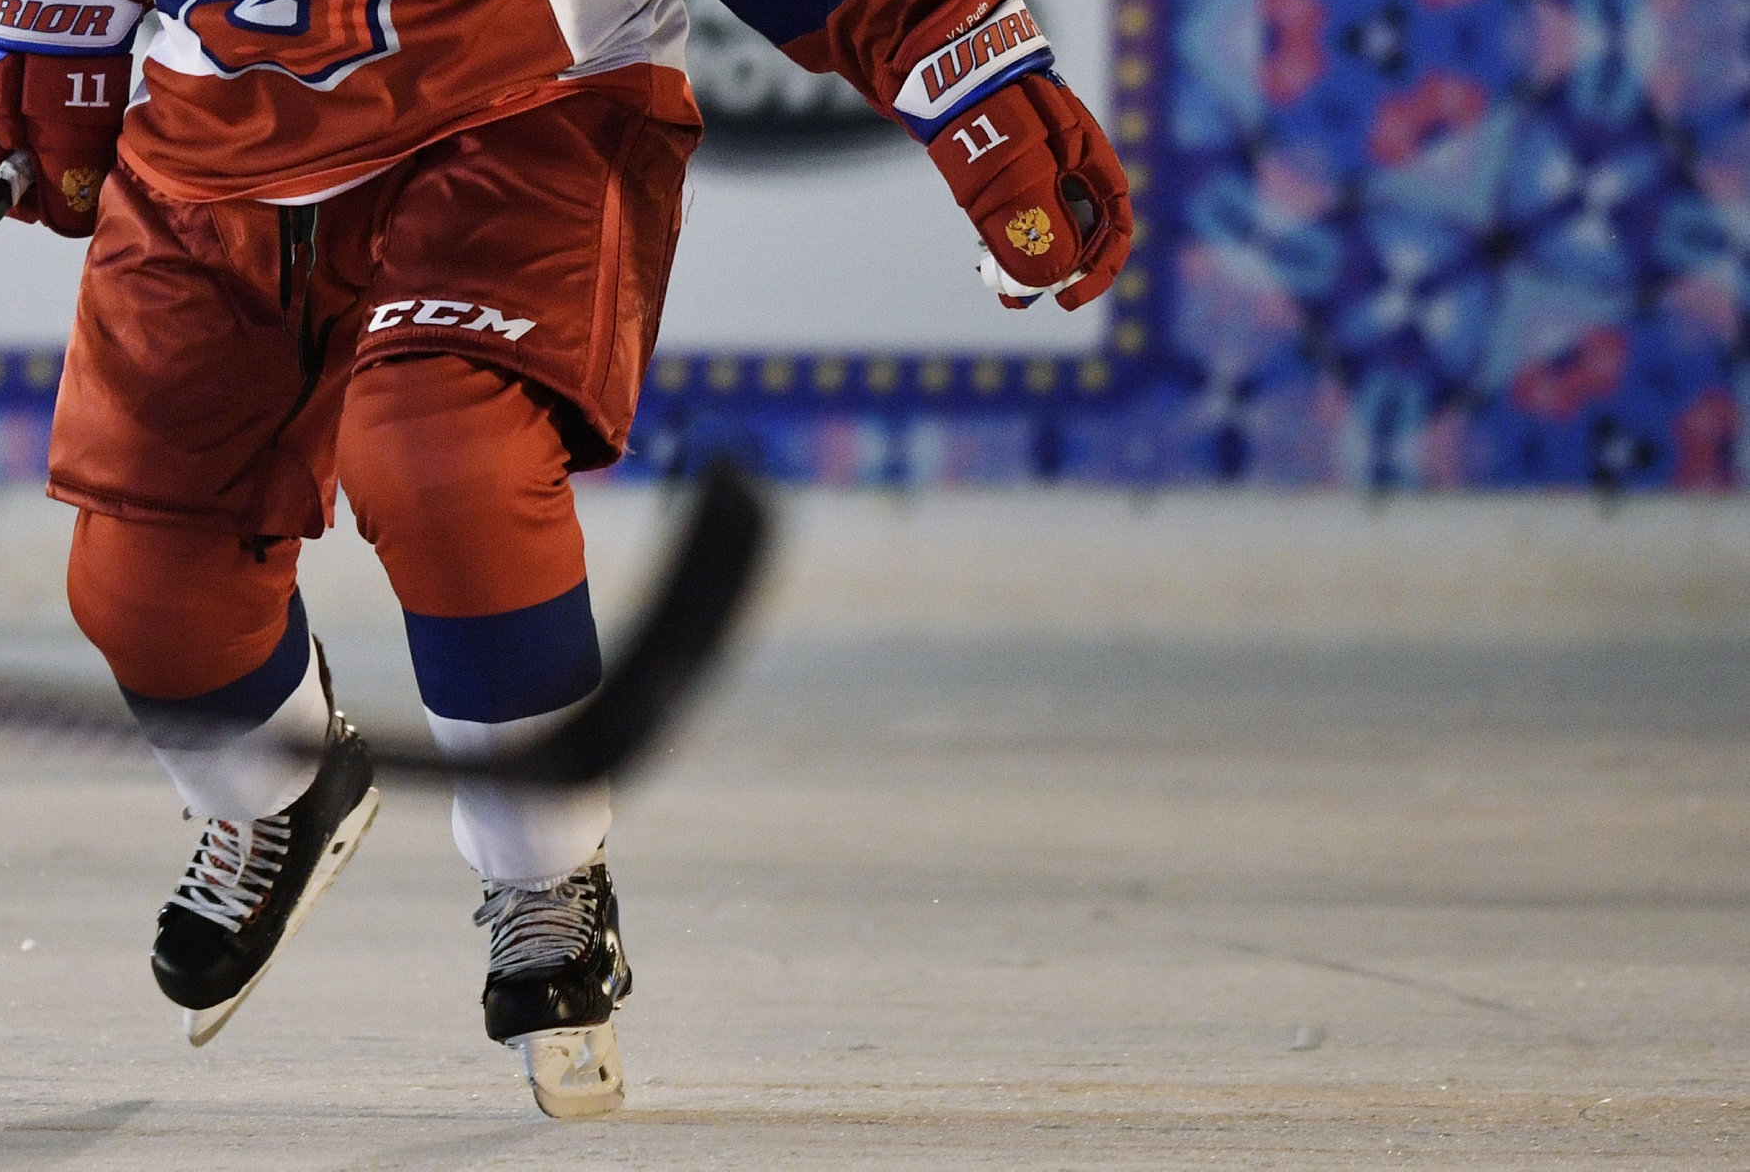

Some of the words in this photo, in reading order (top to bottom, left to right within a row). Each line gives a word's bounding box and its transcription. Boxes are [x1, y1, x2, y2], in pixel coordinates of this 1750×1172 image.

[965, 1, 989, 28] Putin
[65, 72, 110, 107] 11
[953, 113, 1010, 164] 11
[367, 299, 537, 342] CCM
